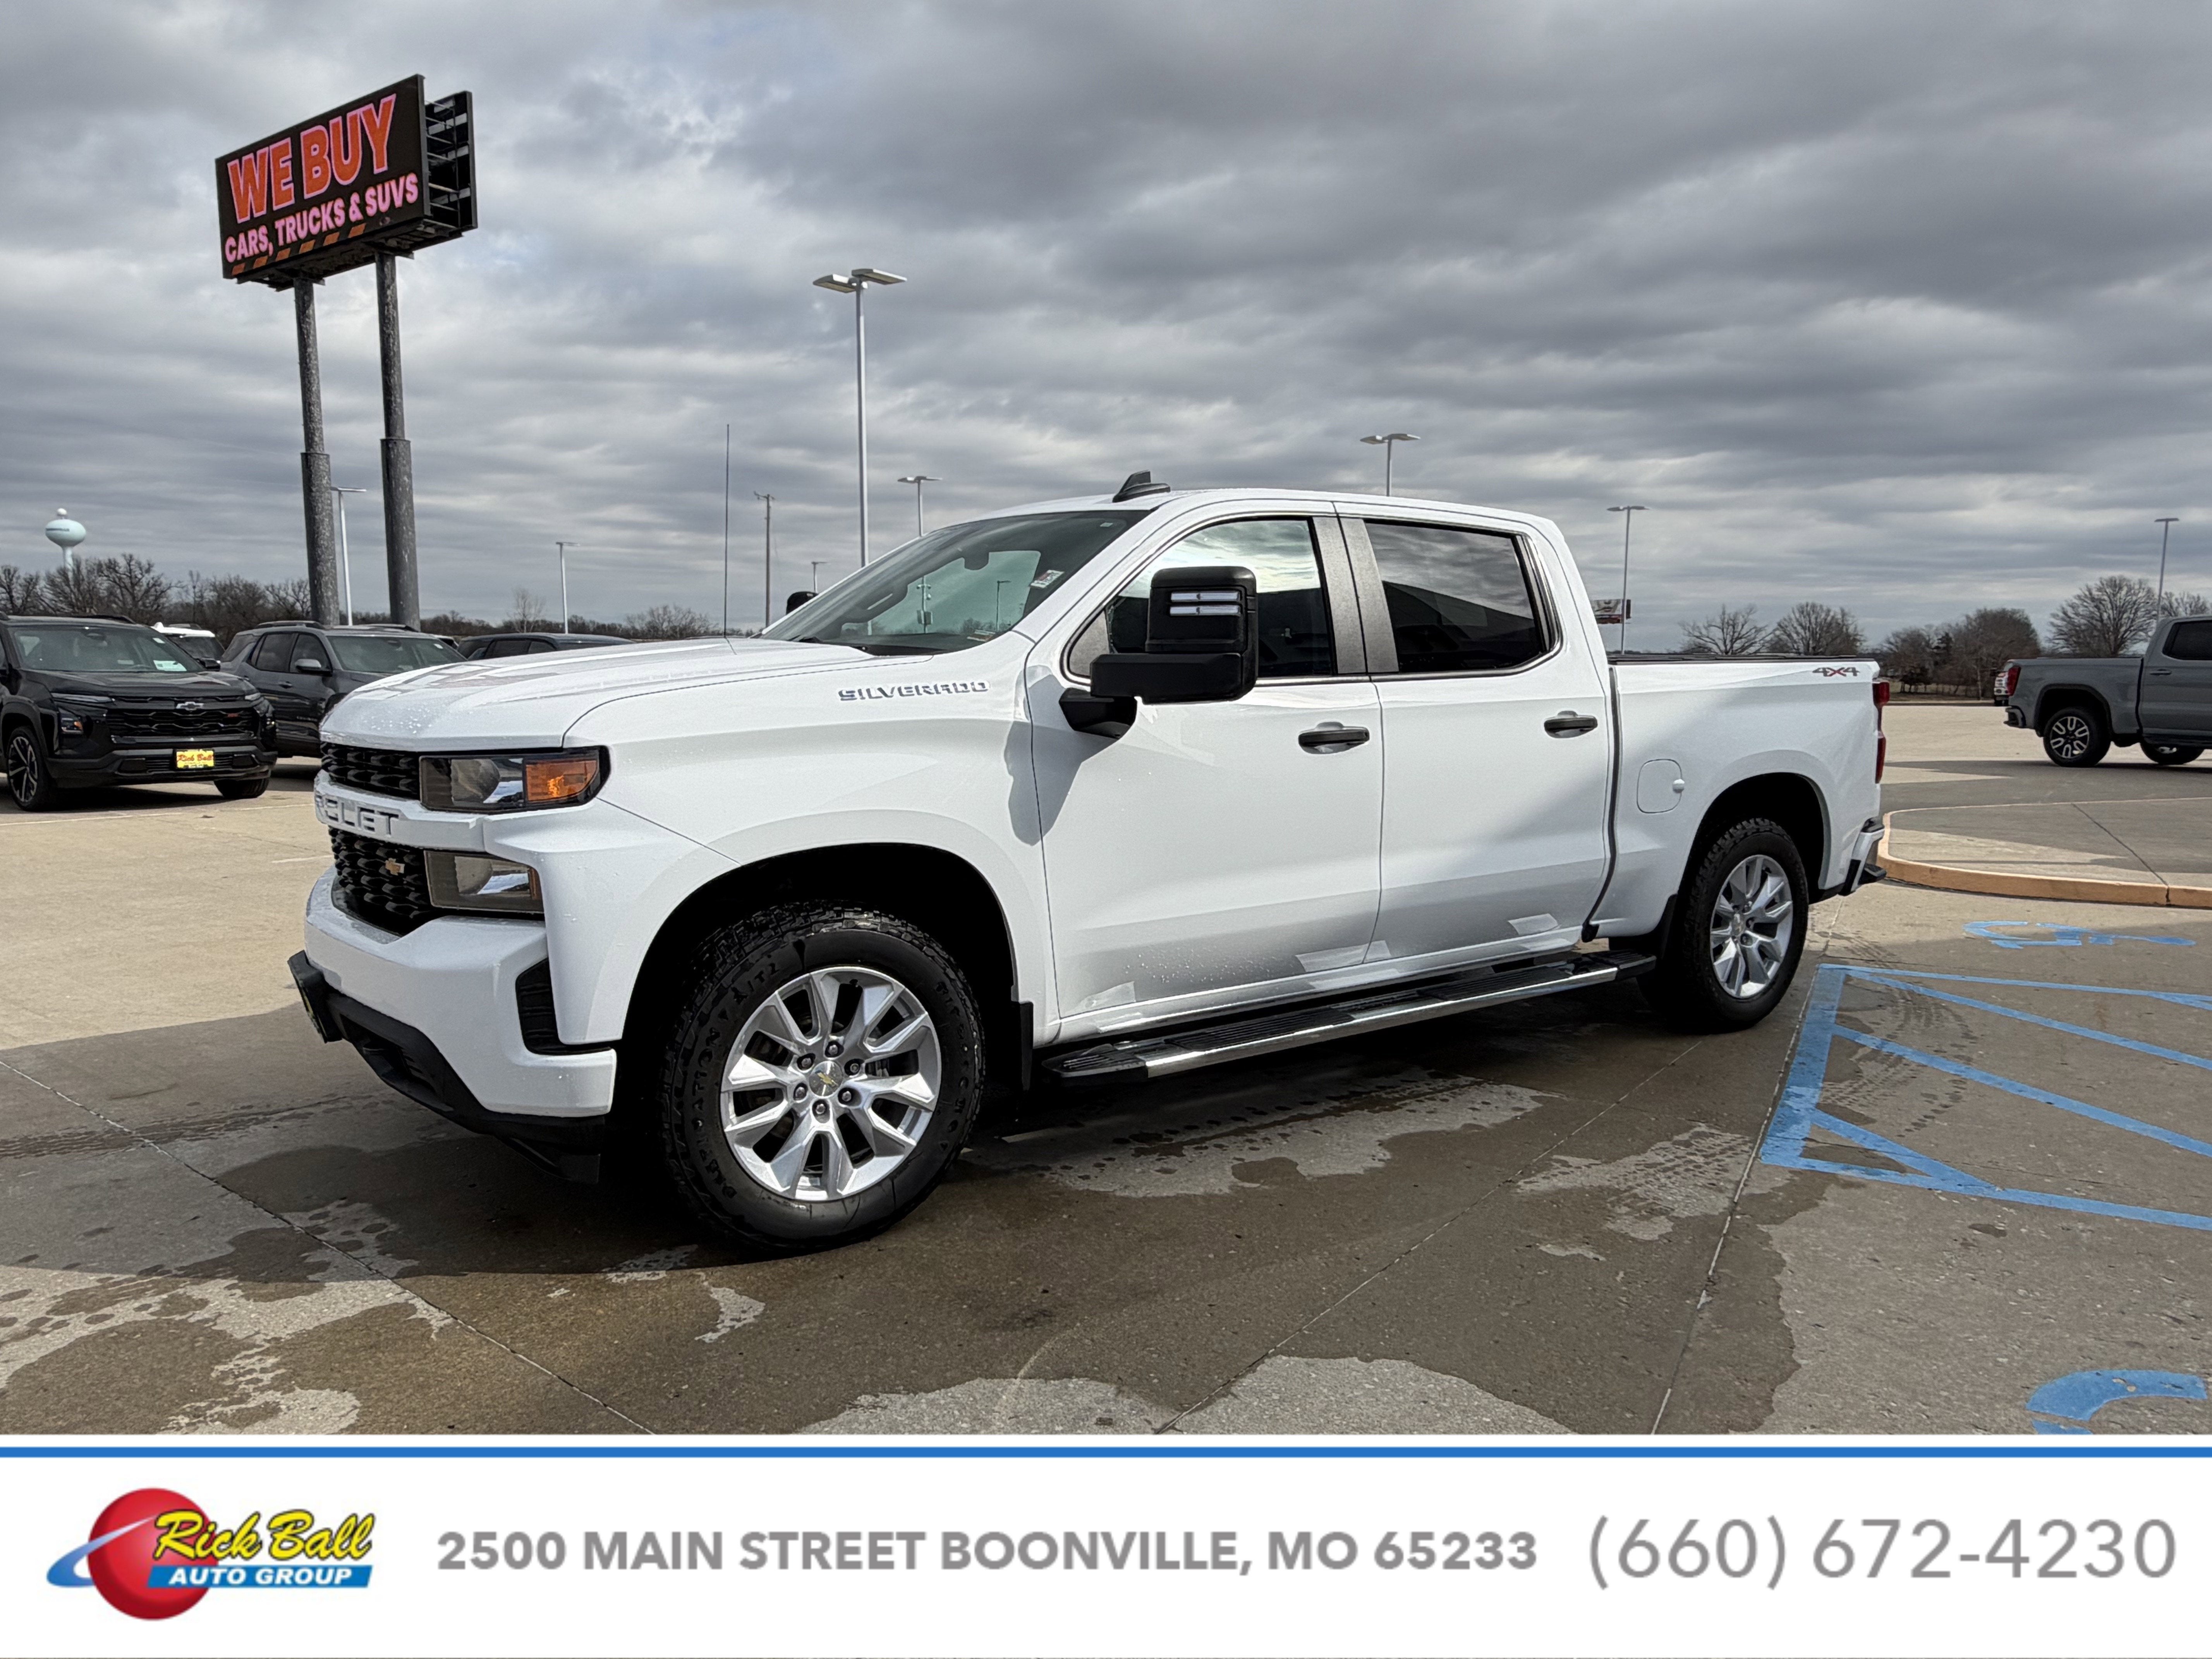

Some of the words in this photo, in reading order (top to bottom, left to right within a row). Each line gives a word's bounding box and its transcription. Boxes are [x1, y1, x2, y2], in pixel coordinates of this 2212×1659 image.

[227, 137, 295, 224] WE
[301, 93, 396, 199] BUY
[225, 225, 273, 263] CARS,
[275, 198, 346, 246] TRUCKS
[349, 192, 364, 222] &
[365, 172, 419, 217] SUVS
[838, 681, 990, 701] SILVERADO
